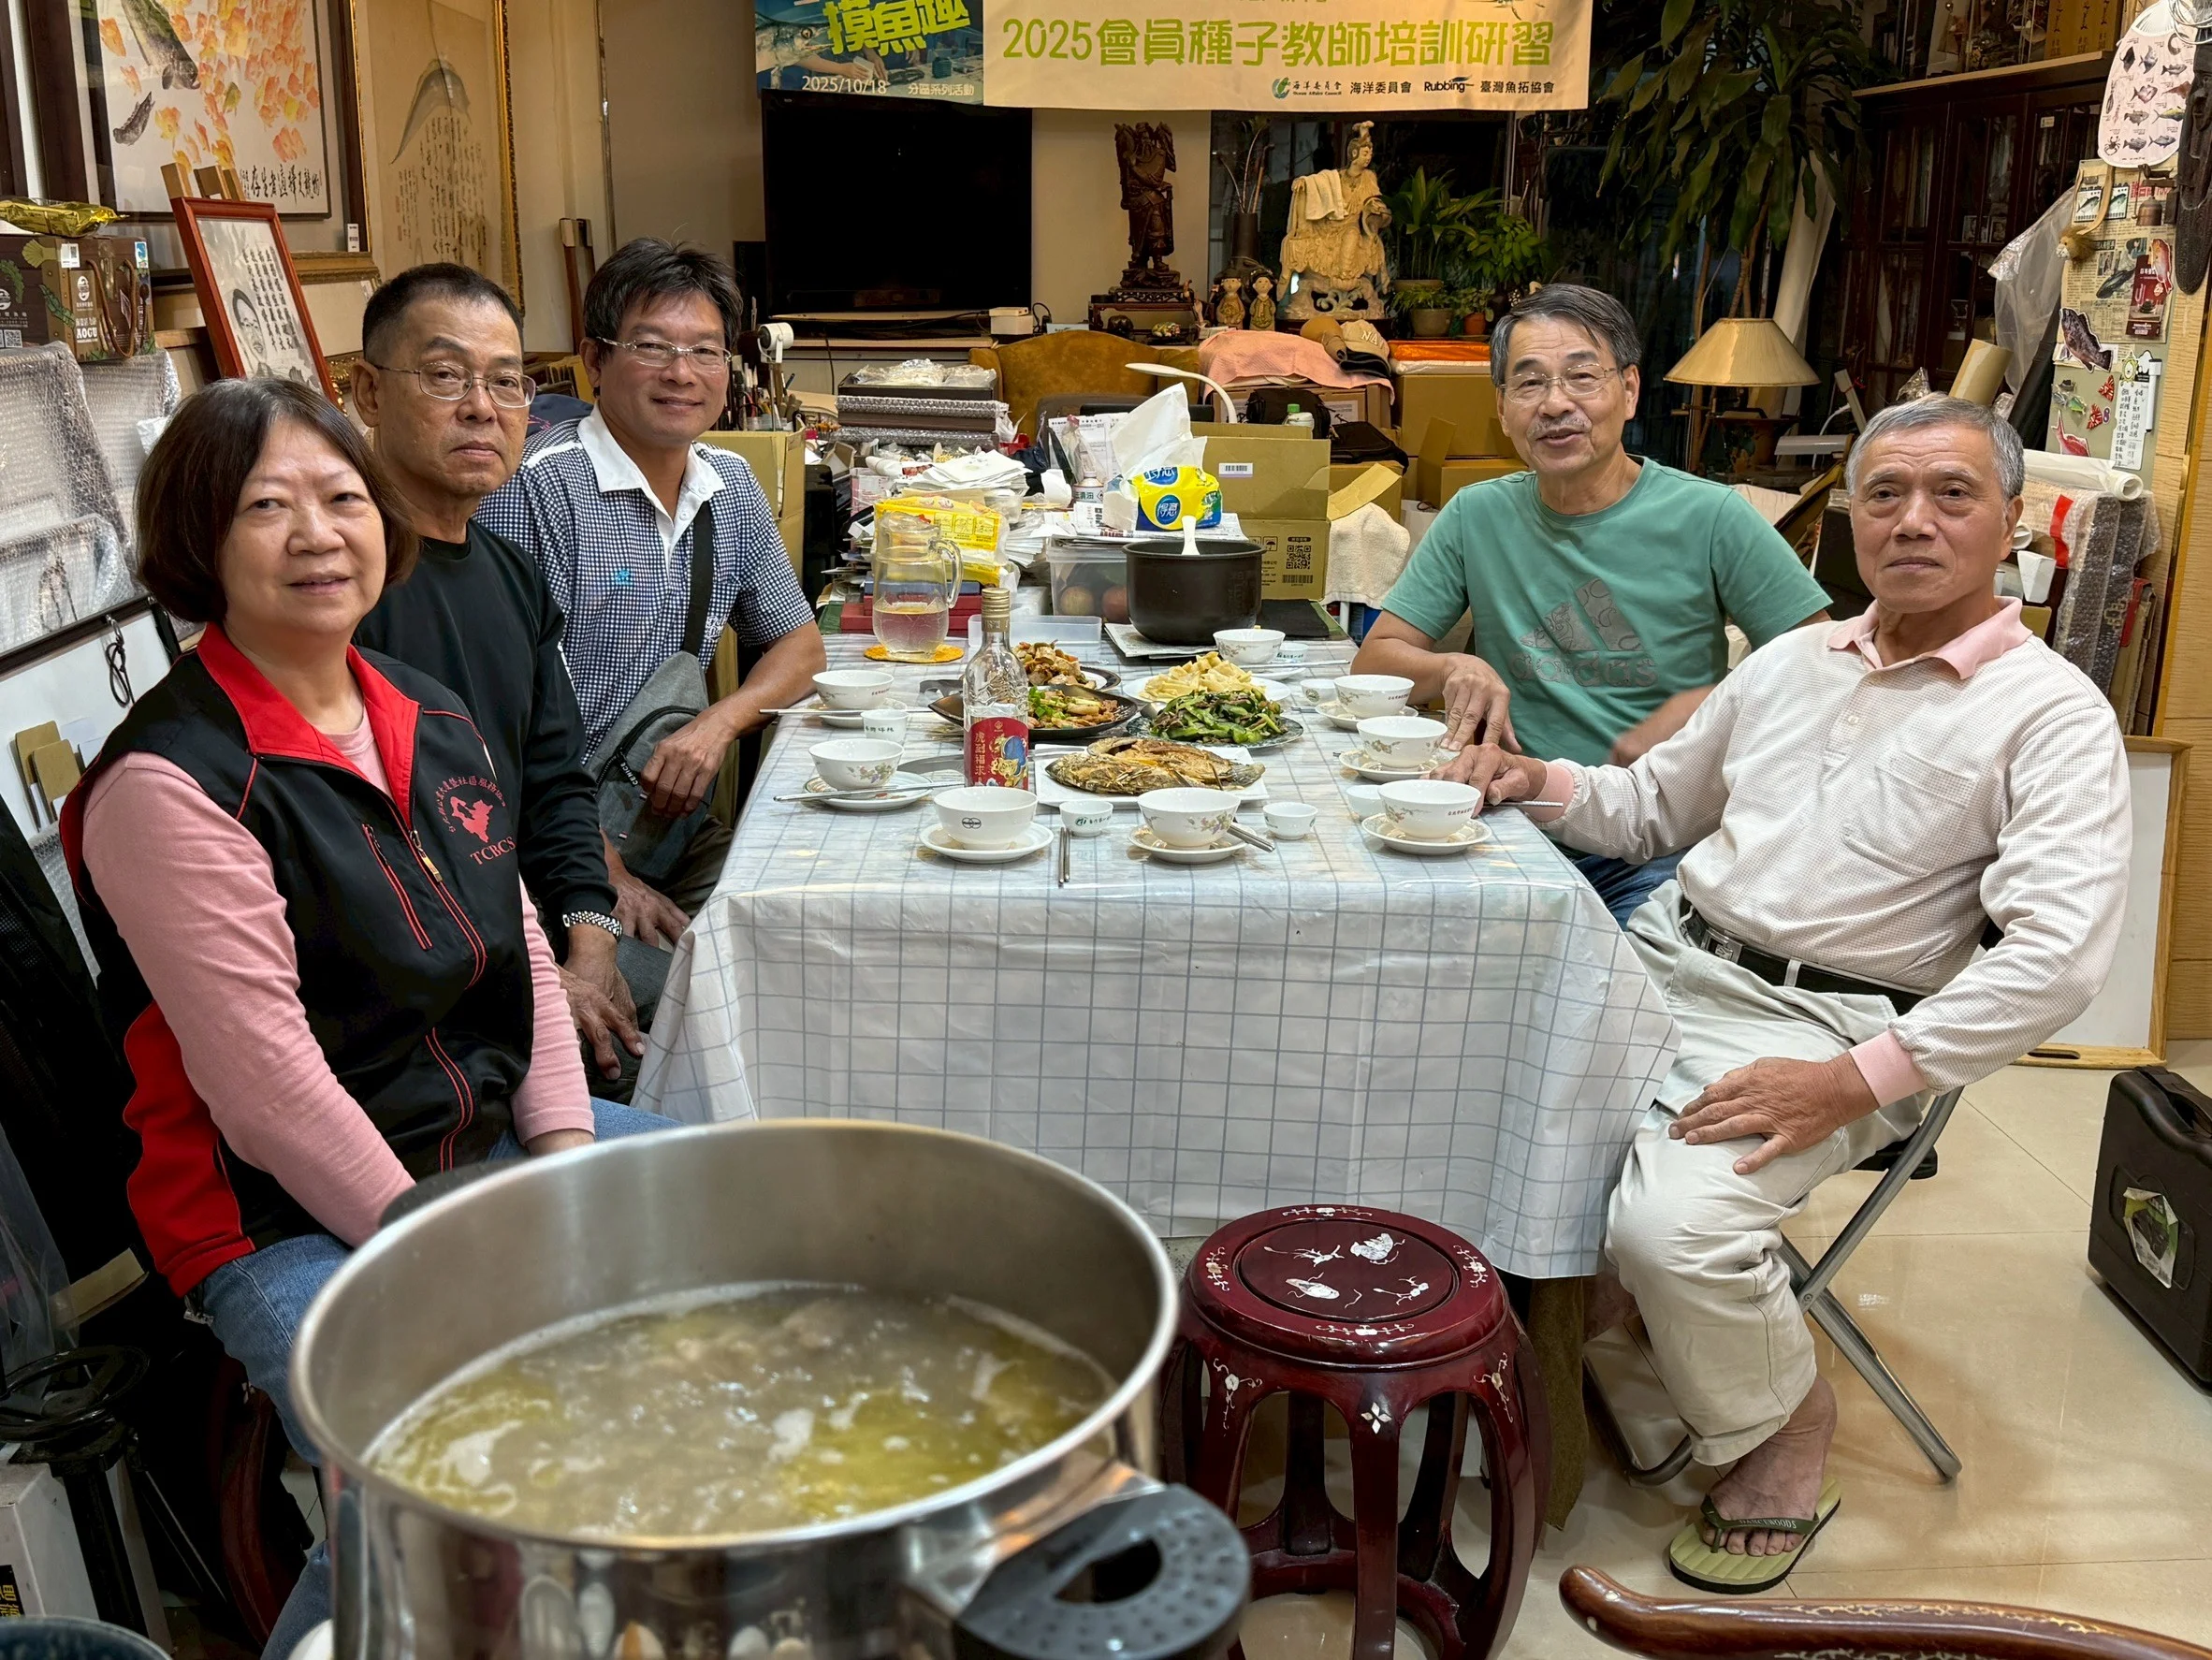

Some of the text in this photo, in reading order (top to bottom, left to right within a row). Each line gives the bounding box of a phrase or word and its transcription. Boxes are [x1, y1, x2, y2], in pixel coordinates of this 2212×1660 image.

[1002, 17, 1554, 67] 2025會員種子教師培訓研習
[802, 75, 975, 96] 2025/10/18 分區系列活動
[1349, 81, 1412, 95] 海洋委員會
[1424, 80, 1466, 93] Rubbing
[1480, 80, 1555, 94] 臺灣魚拓協會
[1157, 502, 1179, 517] 得意
[470, 836, 517, 866] TCBCS
